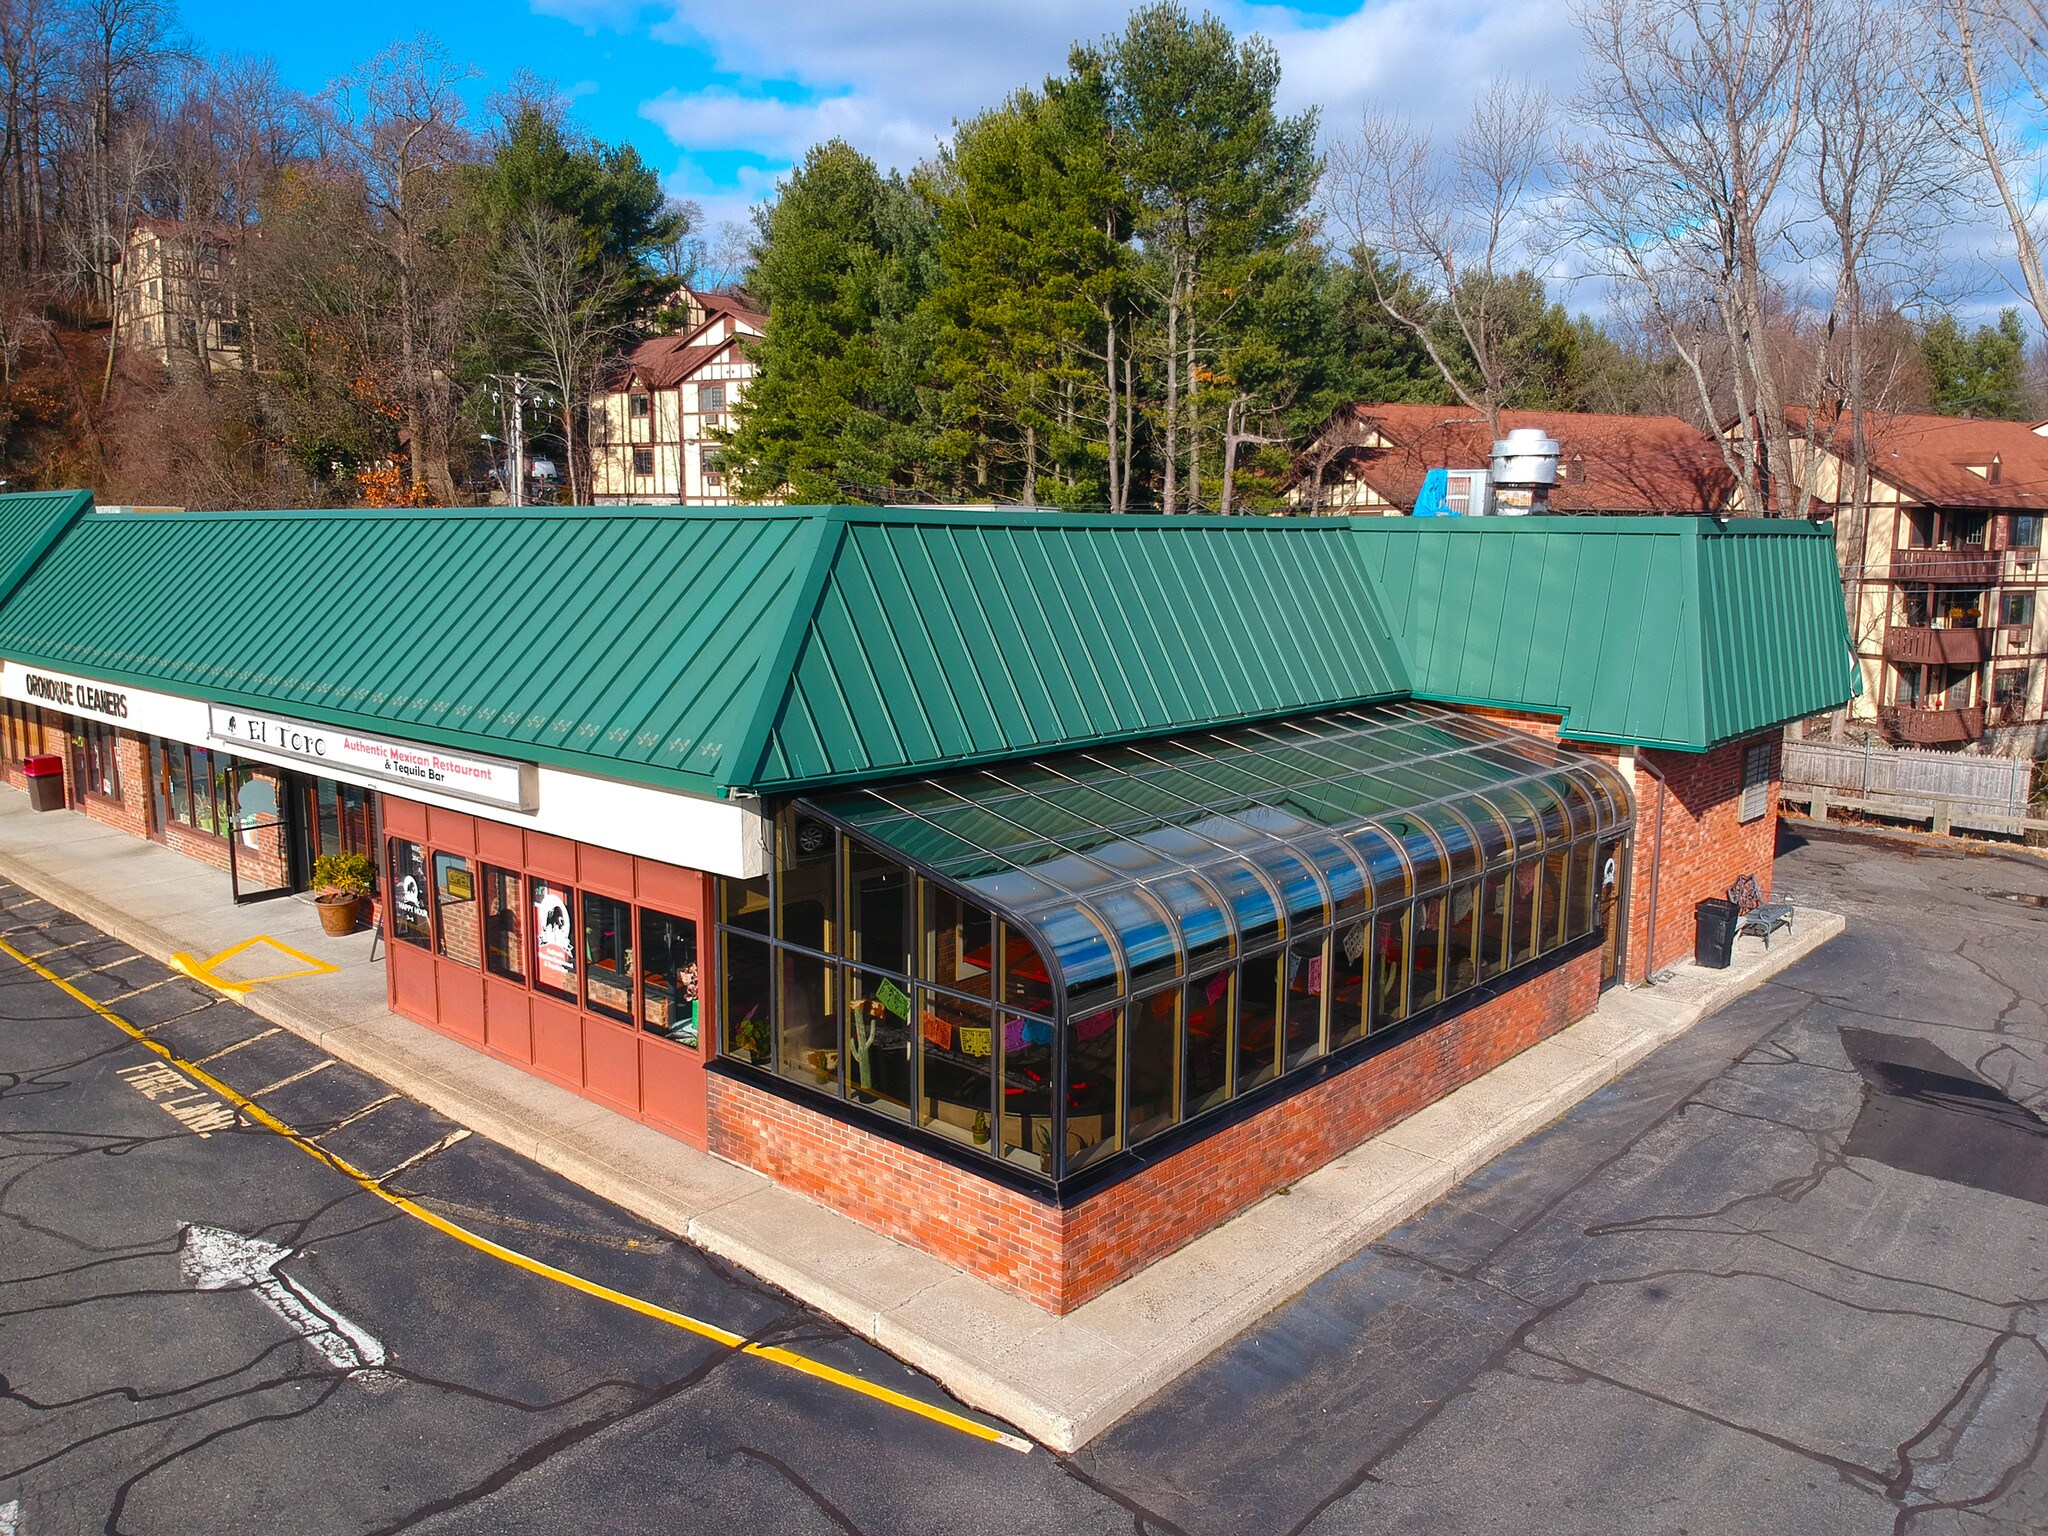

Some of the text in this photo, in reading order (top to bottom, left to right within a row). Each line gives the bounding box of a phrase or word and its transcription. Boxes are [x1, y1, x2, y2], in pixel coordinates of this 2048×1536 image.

[76, 684, 128, 719] CLEANERS
[247, 720, 326, 756] El Toro
[343, 737, 492, 781] Authentic Mexican Restaurant
[384, 758, 445, 782] & Tequila Bar
[449, 870, 471, 888] OPEN
[398, 902, 414, 914] HAPPY
